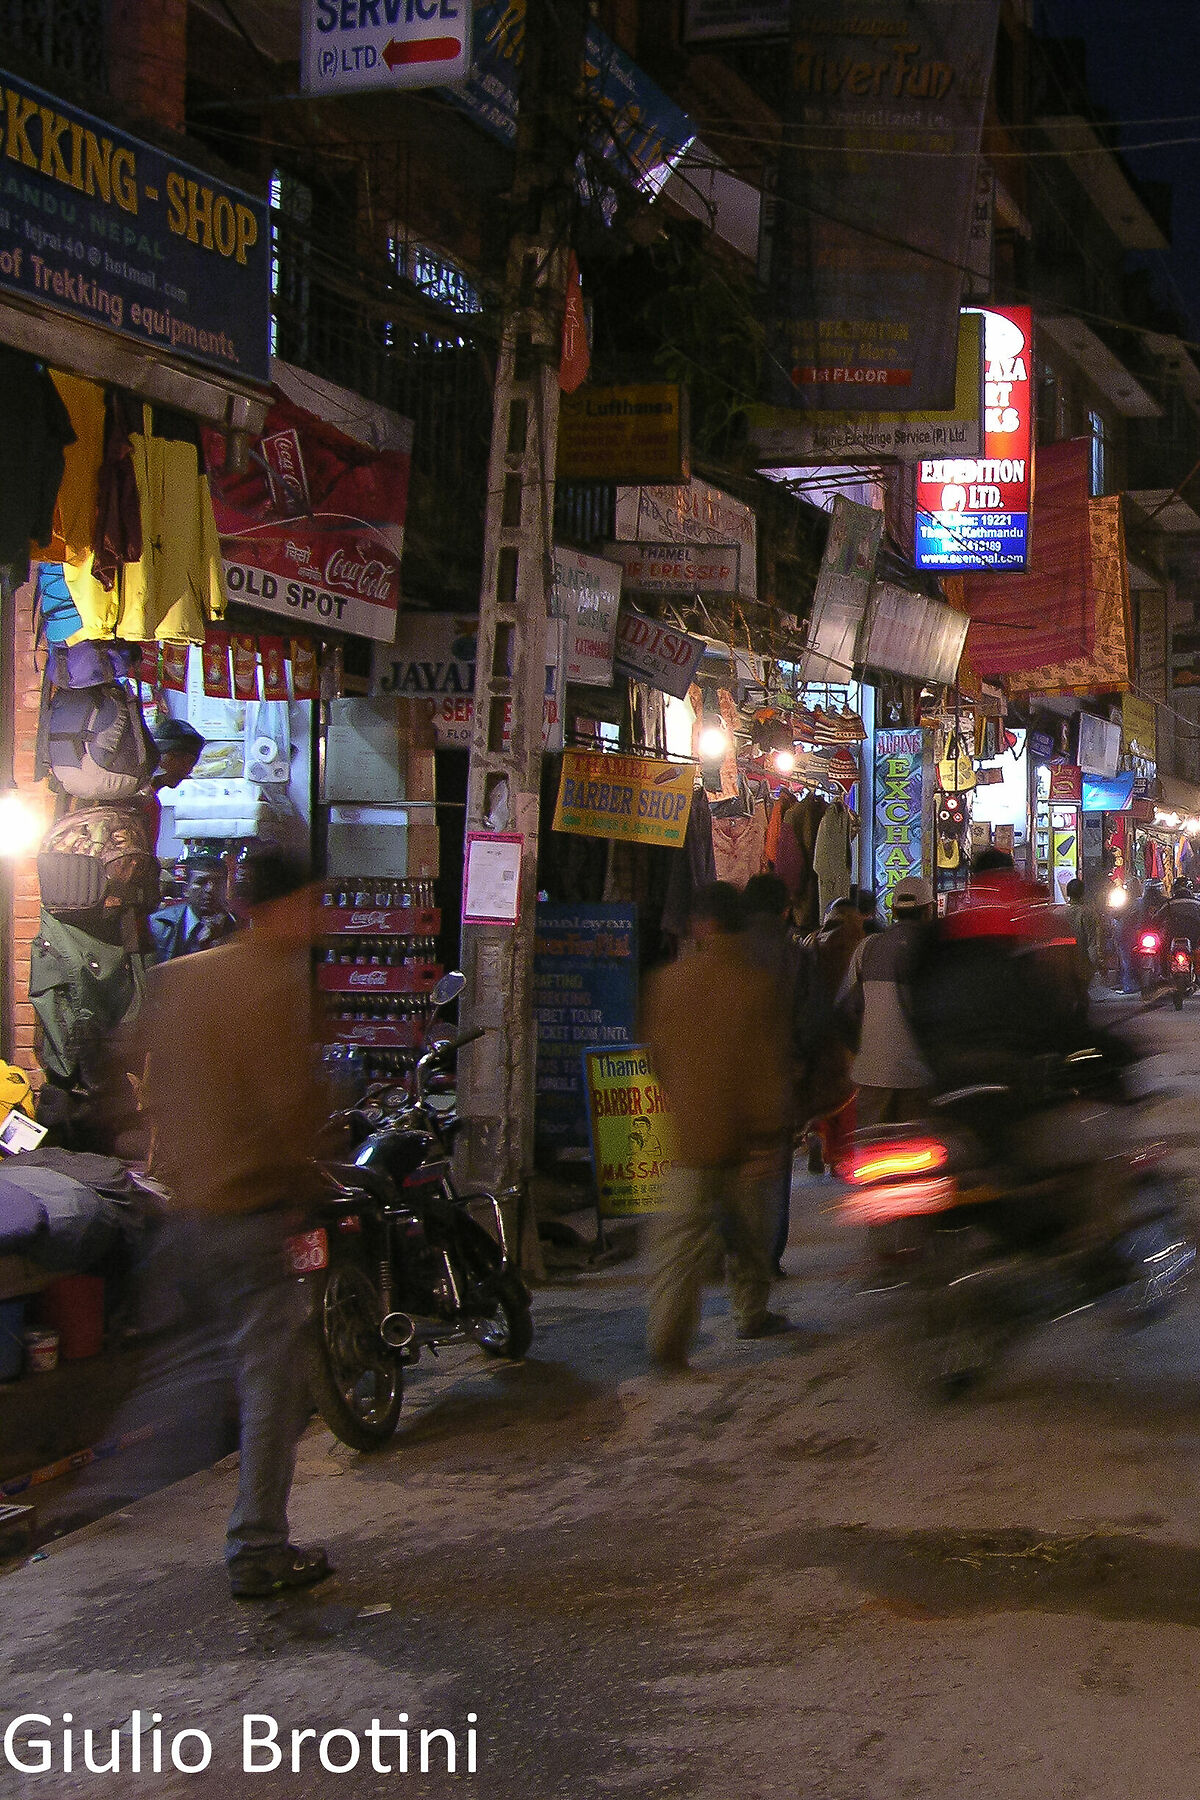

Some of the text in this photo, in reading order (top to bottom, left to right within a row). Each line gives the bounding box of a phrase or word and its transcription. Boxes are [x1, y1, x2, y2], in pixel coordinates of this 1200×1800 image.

[0, 86, 138, 216] KKING
[166, 172, 259, 266] SHOP
[31, 255, 124, 327] Trekking
[833, 368, 888, 383] FLOOR
[894, 428, 931, 444] Service
[920, 459, 1025, 484] EXPEDITION
[968, 484, 1005, 509] LTD.
[962, 526, 1024, 539] Kathmandu
[285, 582, 348, 620] SPOT
[637, 788, 688, 822] SHOP
[592, 1088, 642, 1116] BARBER
